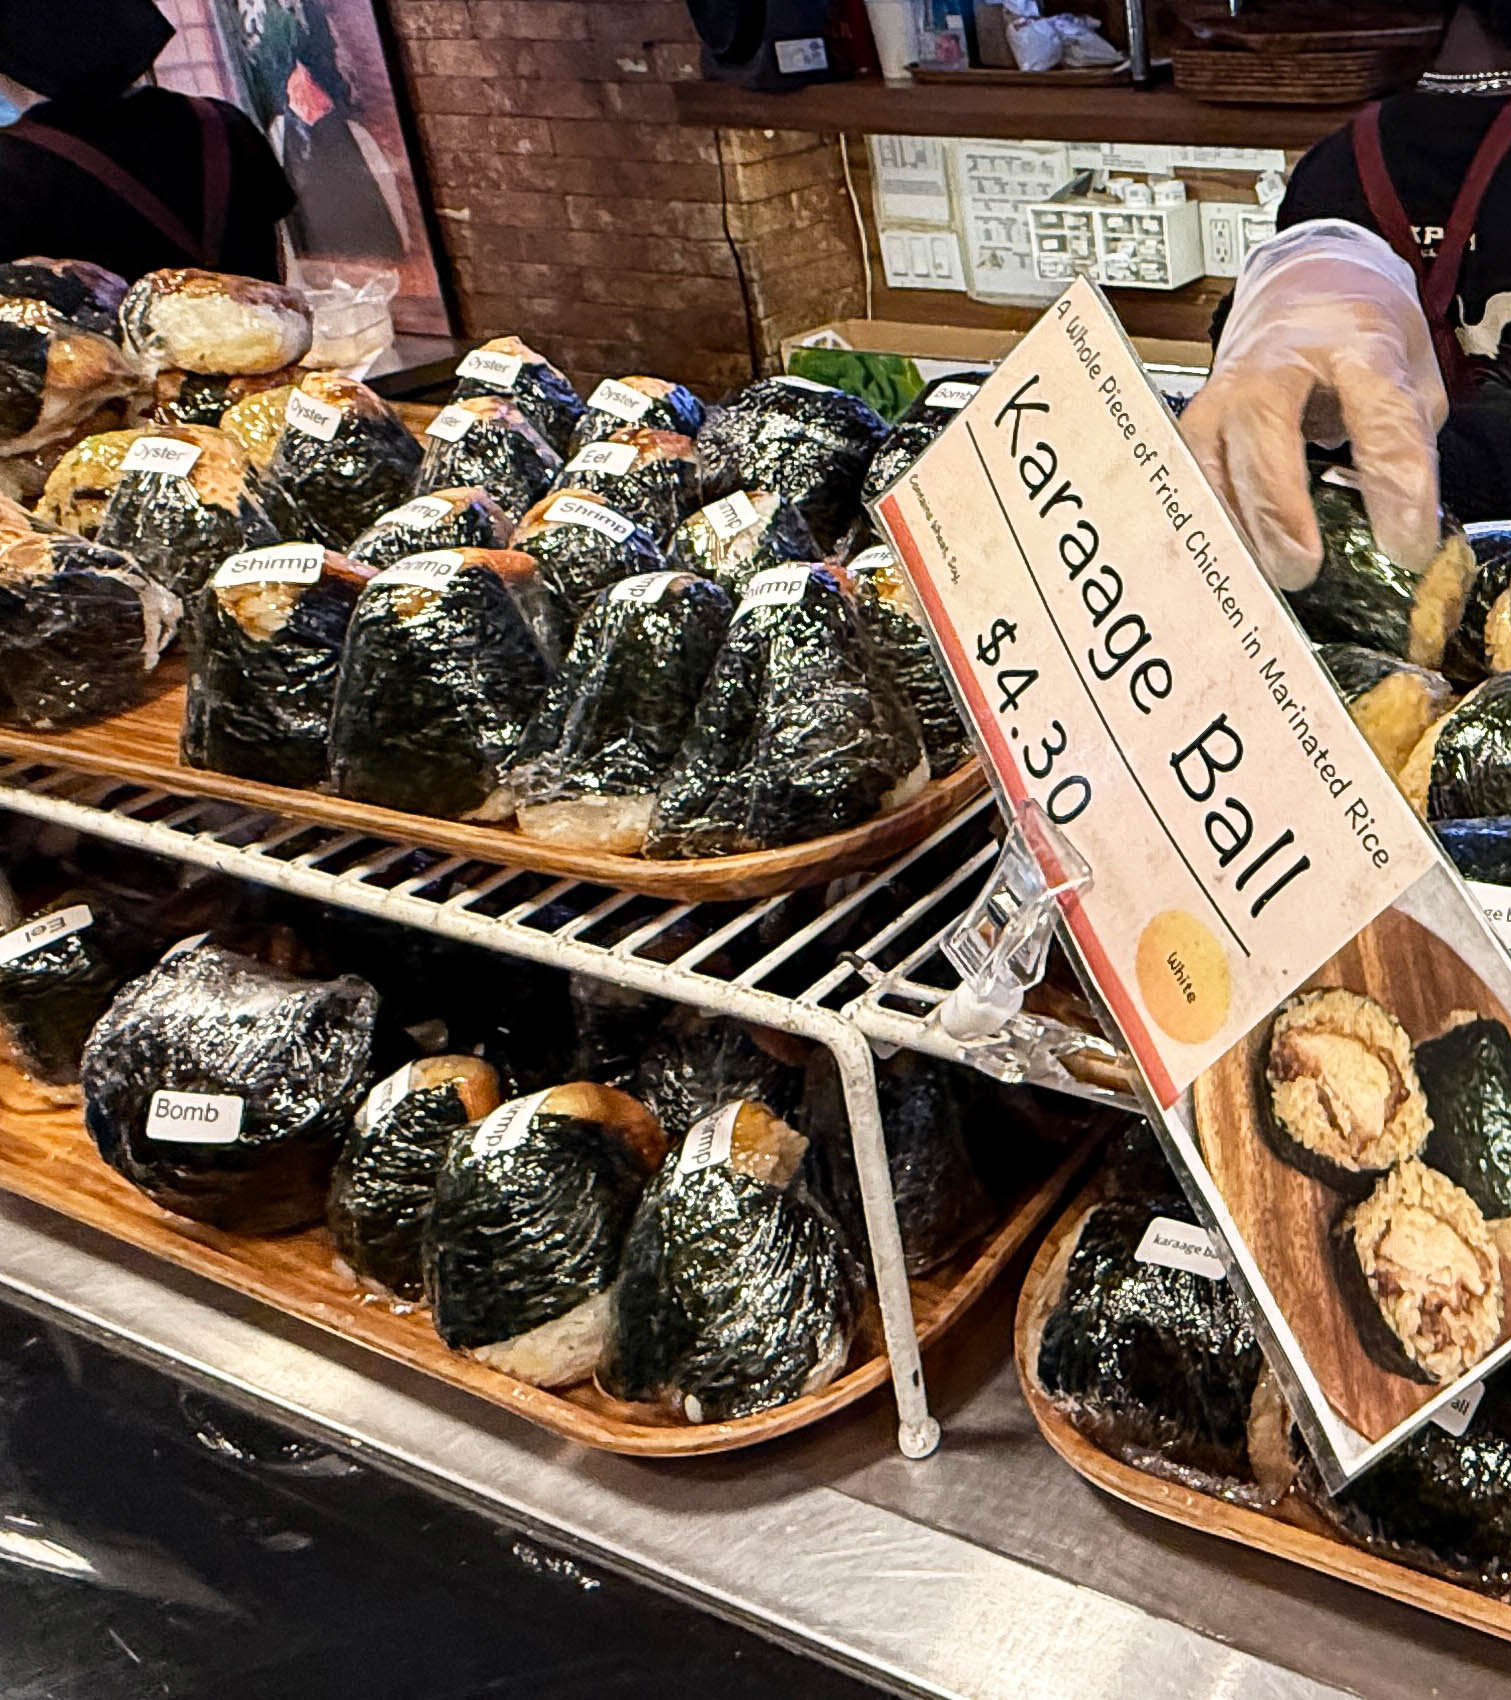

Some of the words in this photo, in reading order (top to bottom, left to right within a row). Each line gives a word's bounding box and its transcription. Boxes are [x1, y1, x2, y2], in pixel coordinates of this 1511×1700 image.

[581, 450, 612, 465] Eel
[1056, 299, 1072, 320] A
[1066, 315, 1102, 380] Whole
[1099, 376, 1137, 440] Piece
[1133, 442, 1158, 467] of
[1149, 464, 1193, 532] Fried
[1185, 530, 1244, 629] Chicken
[1242, 626, 1262, 661] in
[1259, 657, 1353, 800] Marinated
[1344, 797, 1389, 869] Rice
[994, 375, 1173, 715] Karaage
[1170, 713, 1310, 919] Ball
[976, 617, 1092, 825] $4.30
[25, 916, 66, 943] Eel
[1166, 951, 1196, 1004] White
[155, 1097, 219, 1123] Bomb
[1152, 1233, 1202, 1256] karaage
[1450, 1399, 1470, 1416] all
